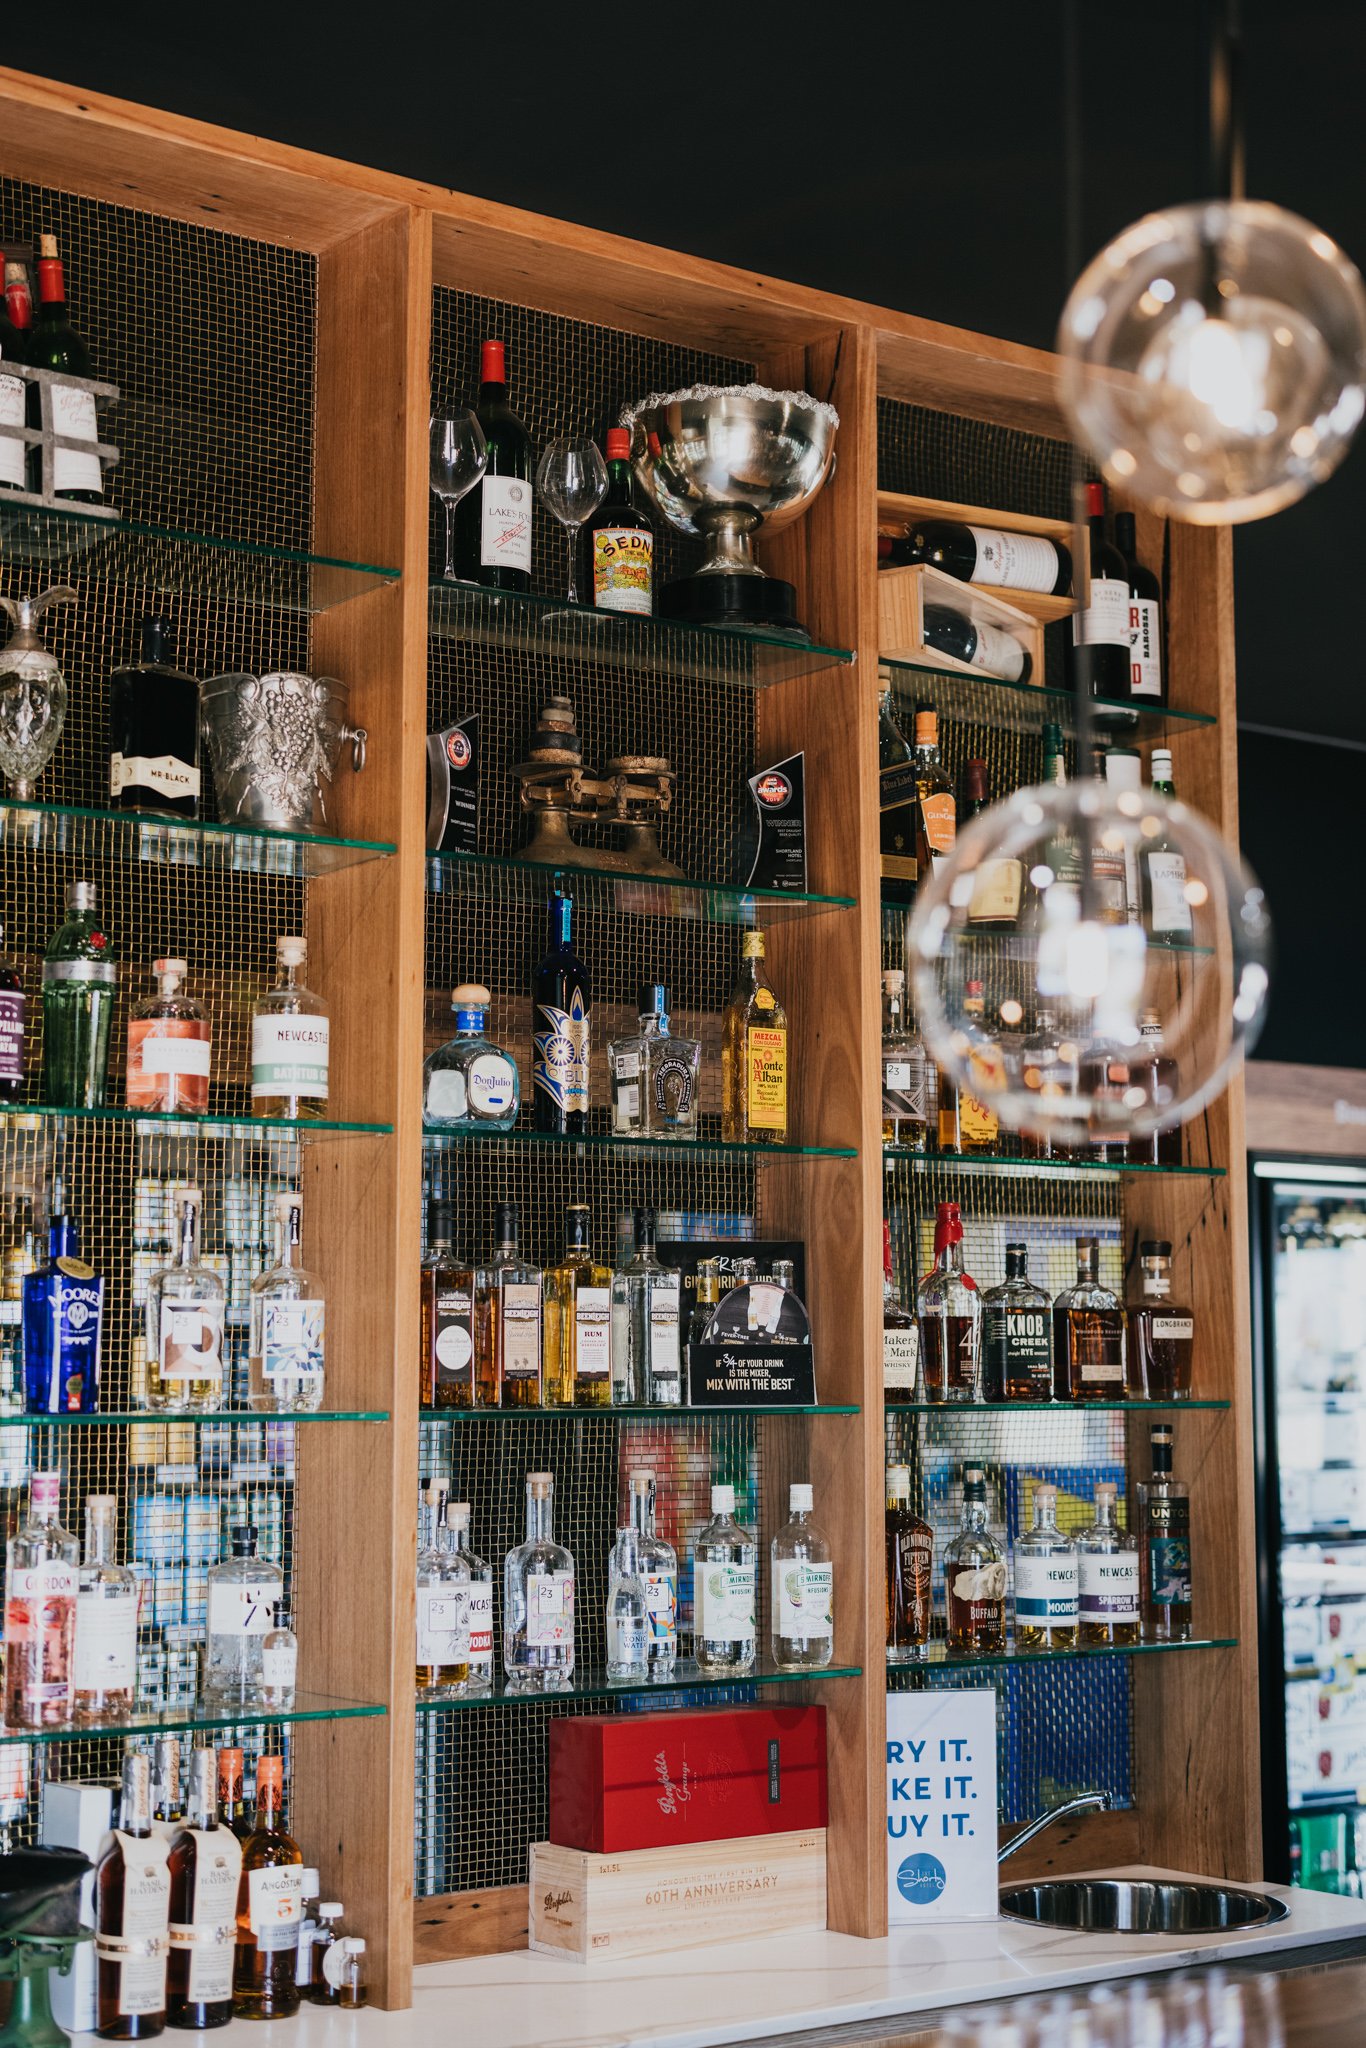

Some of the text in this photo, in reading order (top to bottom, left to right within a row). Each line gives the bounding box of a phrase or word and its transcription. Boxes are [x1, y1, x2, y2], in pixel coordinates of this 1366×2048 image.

[1142, 608, 1150, 658] BAROSSA
[165, 772, 190, 784] BLACK
[881, 774, 913, 792] Blue Label
[757, 786, 787, 794] awards
[455, 800, 476, 811] WINNER
[277, 1030, 328, 1044] NEWCASTLE
[754, 1033, 782, 1041] MEZCAL
[658, 1062, 690, 1079] HERRADURA
[753, 1059, 784, 1072] Monte
[888, 1065, 900, 1075] 23
[273, 1067, 318, 1081] BATHTUB
[753, 1071, 783, 1083] Alban
[276, 1315, 289, 1327] 23
[1007, 1314, 1044, 1336] KNOB
[1156, 1320, 1192, 1328] LONGBRANCH
[721, 1332, 750, 1340] FEVER-TREE
[958, 1326, 975, 1356] 4
[1011, 1337, 1049, 1346] CREEK
[890, 1347, 916, 1357] Mark
[1021, 1348, 1034, 1356] RYE
[722, 1353, 738, 1370] 3/4
[746, 1359, 763, 1368] YOUR
[764, 1359, 784, 1368] DRINK
[729, 1369, 771, 1378] IS THE MIXER,
[706, 1379, 724, 1391] MIX
[725, 1379, 750, 1391] WITH
[751, 1379, 769, 1390] THE
[904, 1551, 929, 1566] FIFTEEN
[25, 1574, 74, 1590] GRDON
[800, 1574, 831, 1583] SMIRNOFF
[540, 1587, 553, 1599] 23
[647, 1586, 659, 1597] 23
[1098, 1597, 1132, 1605] SPARROW
[431, 1602, 444, 1615] 23
[970, 1607, 998, 1619] BUFFALO
[886, 1739, 972, 1763] RY IT.
[657, 1750, 677, 1814] Penfolds
[676, 1762, 691, 1801] Grange
[892, 1776, 977, 1800] KE IT.
[887, 1813, 974, 1838] UY IT.
[599, 1864, 621, 1874] 1x1.5L
[657, 1875, 703, 1887] HONOURING
[704, 1873, 717, 1882] THE
[897, 1868, 945, 1889] Shorty
[646, 1875, 778, 1905] 60TH ANNIVERSARY
[544, 1890, 574, 1912] Penfolds
[684, 1897, 741, 1911] LIMITED RELEASE
[277, 1898, 293, 1918] 5
